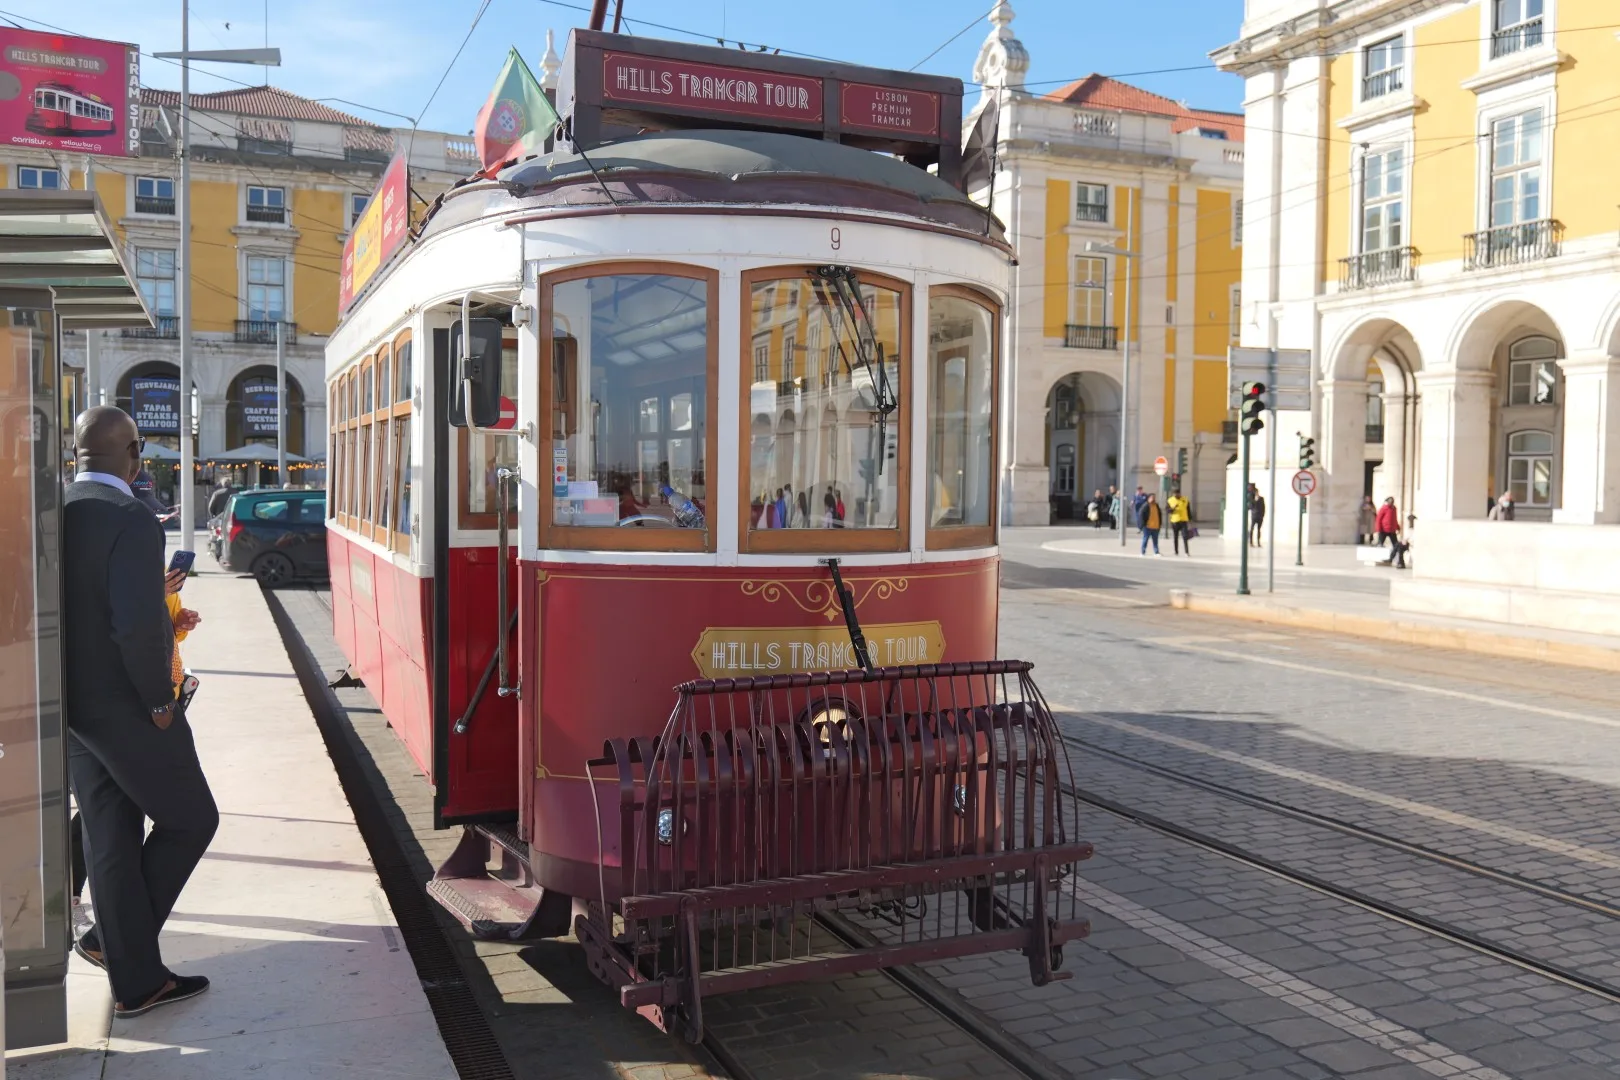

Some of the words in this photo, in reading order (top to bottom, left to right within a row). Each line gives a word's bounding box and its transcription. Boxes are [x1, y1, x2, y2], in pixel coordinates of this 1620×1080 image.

[12, 50, 38, 63] HILLS
[39, 53, 76, 67] TRAMCAR
[78, 58, 100, 71] TOUR
[128, 51, 140, 99] TRAM
[616, 66, 673, 95] HILLS
[678, 73, 758, 104] TRAMCAR
[763, 82, 809, 110] TOUR
[875, 91, 908, 103] LISBON
[871, 102, 912, 115] PREMIUM
[871, 114, 911, 127] TRAMCAR
[129, 104, 140, 151] STOP
[831, 227, 841, 250] 9
[135, 382, 180, 391] CERVEJARIA
[245, 385, 264, 393] BEER
[136, 412, 171, 420] STEAKS
[172, 412, 178, 420] &
[137, 420, 178, 428] SEAFOOD
[712, 642, 781, 670] HILLS
[788, 640, 879, 669] TRAMCR
[884, 635, 928, 664] TOUR
